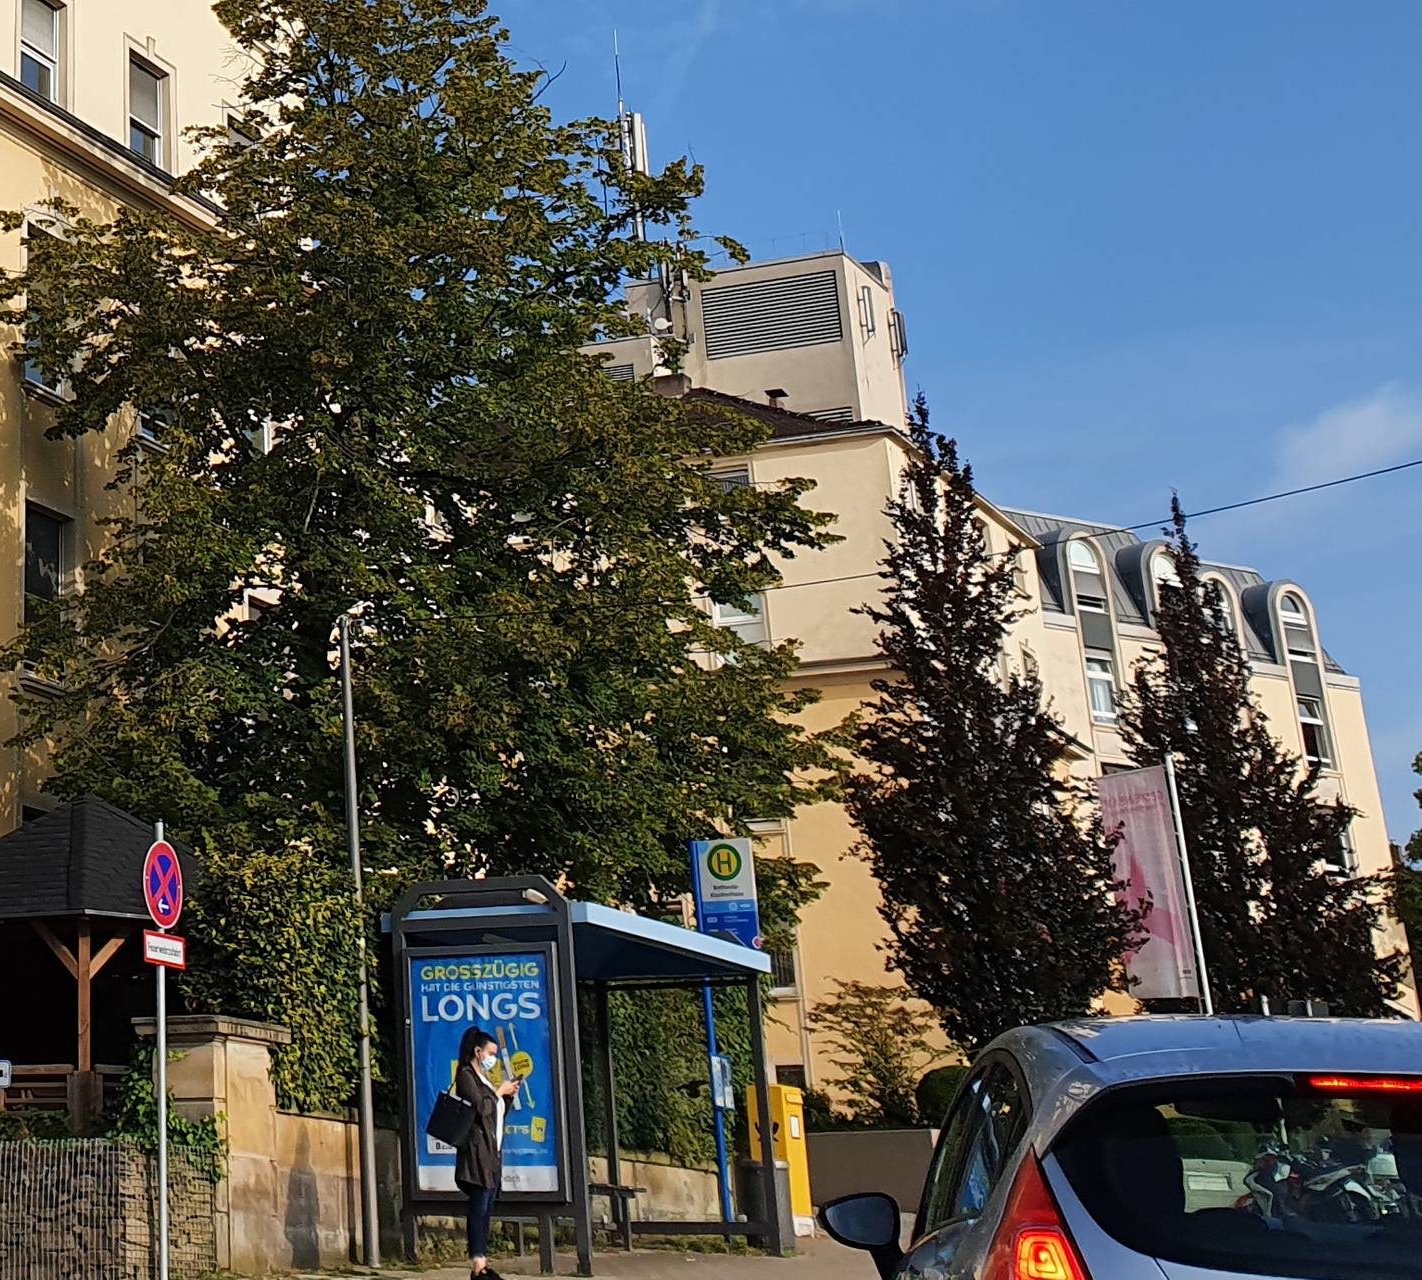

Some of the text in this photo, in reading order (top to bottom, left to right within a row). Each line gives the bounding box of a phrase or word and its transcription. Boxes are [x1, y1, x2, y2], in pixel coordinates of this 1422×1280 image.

[716, 852, 732, 873] H
[420, 959, 539, 980] GROSSZÜGIG
[421, 982, 440, 993] HAT
[443, 982, 460, 992] DIE
[421, 991, 541, 1022] LONGS
